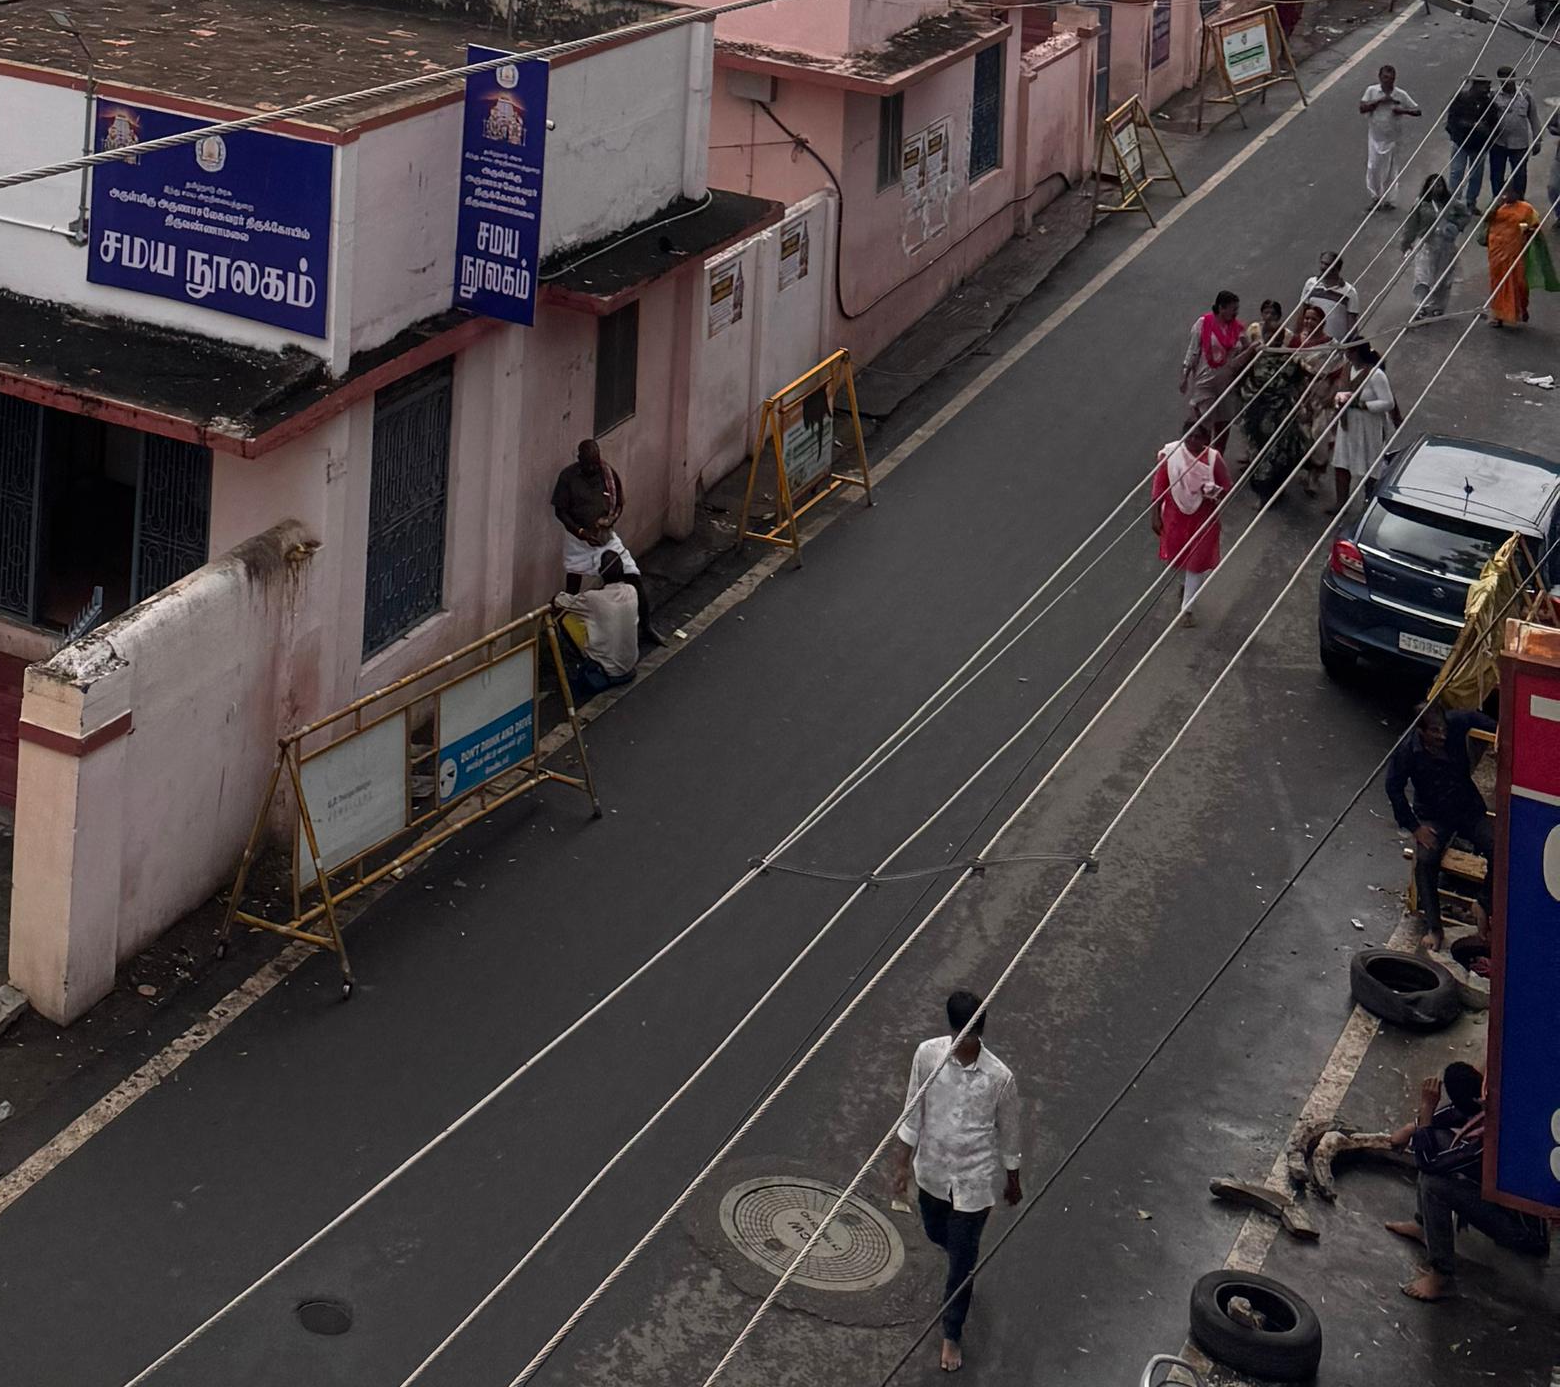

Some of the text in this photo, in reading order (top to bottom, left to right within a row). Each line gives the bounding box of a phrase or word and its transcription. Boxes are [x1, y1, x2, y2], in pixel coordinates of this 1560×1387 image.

[109, 187, 157, 208] அருள்மிகு
[245, 217, 311, 240] திருக்கோயில்
[164, 214, 250, 242] திருவண்ணாமலை
[477, 220, 520, 260] சமய
[99, 229, 316, 309] சமய நூலகம்
[459, 253, 531, 301] நூலகம்
